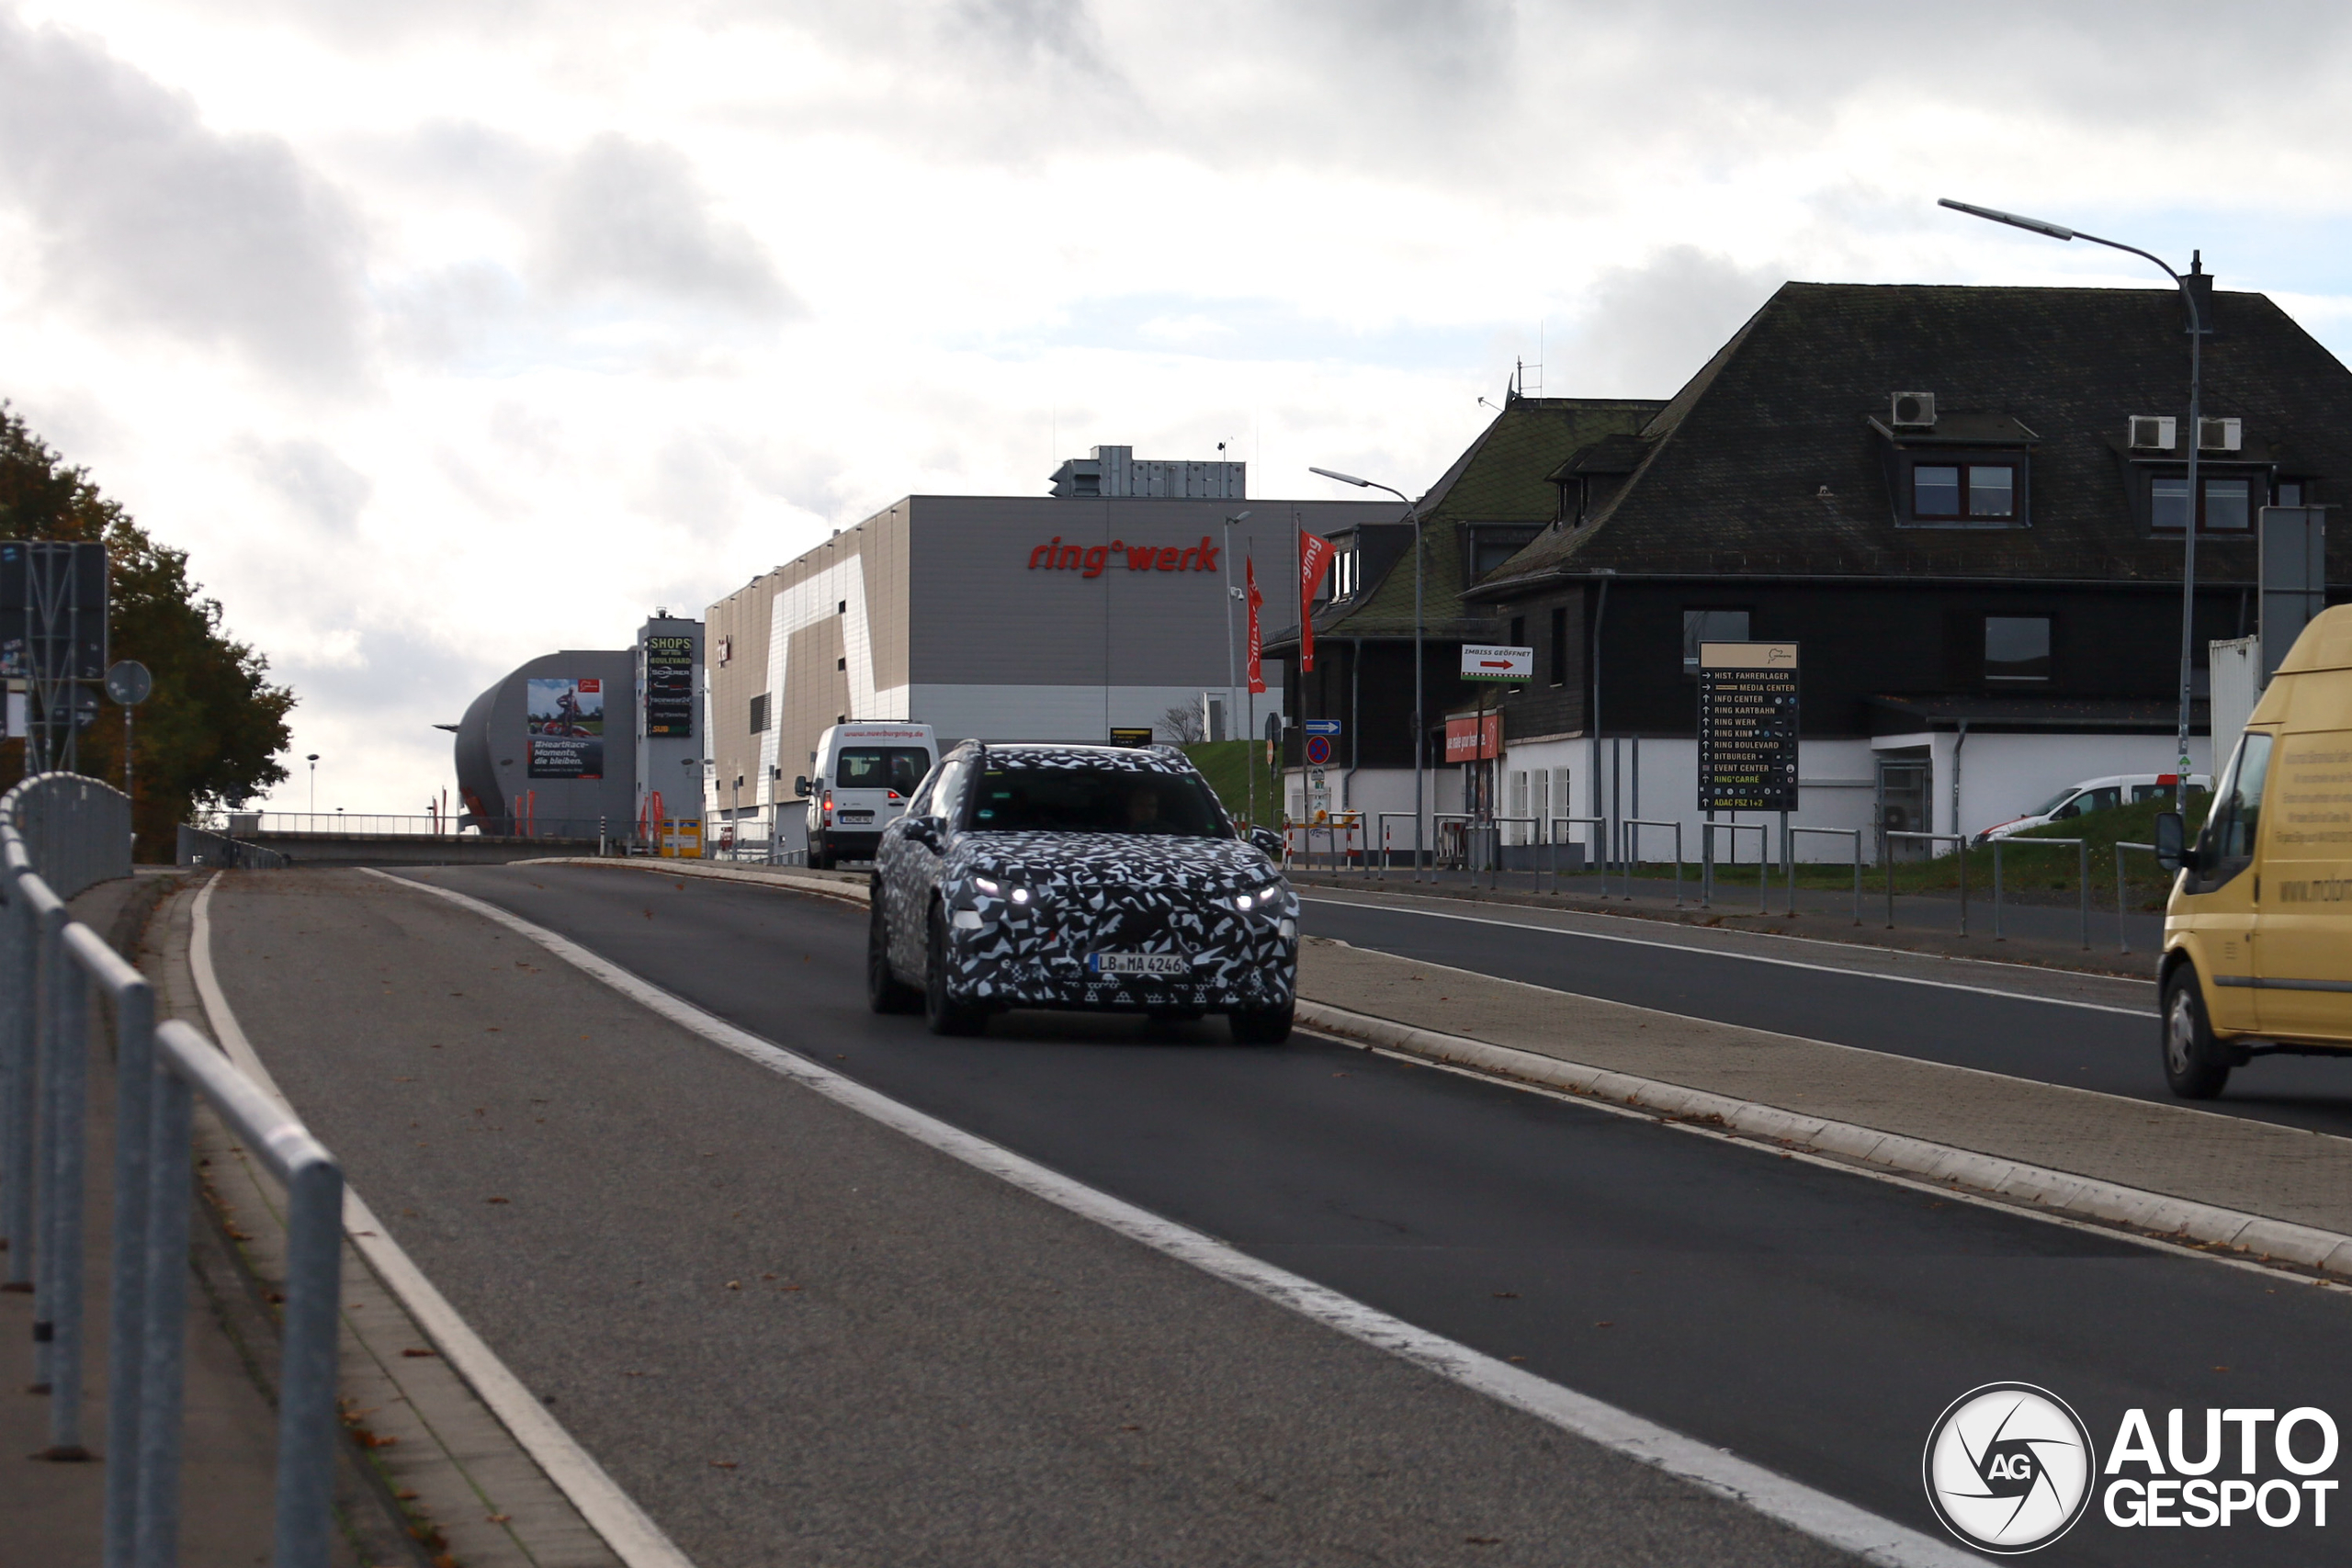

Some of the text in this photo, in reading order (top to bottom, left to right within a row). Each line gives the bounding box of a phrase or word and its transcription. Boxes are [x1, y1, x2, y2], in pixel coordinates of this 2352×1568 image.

[651, 637, 691, 649] SHOPS
[1494, 649, 1531, 657] GEÖFFNET
[1714, 671, 1789, 680] HIST. FAHRERLAGER
[843, 730, 923, 739] www.nuerburgring.de
[535, 740, 589, 749] #HeartRace-
[1713, 752, 1757, 761] BITBURGER
[1713, 798, 1763, 807] ADAC FSZ 1+2
[1099, 956, 1182, 972] LB MA 4246
